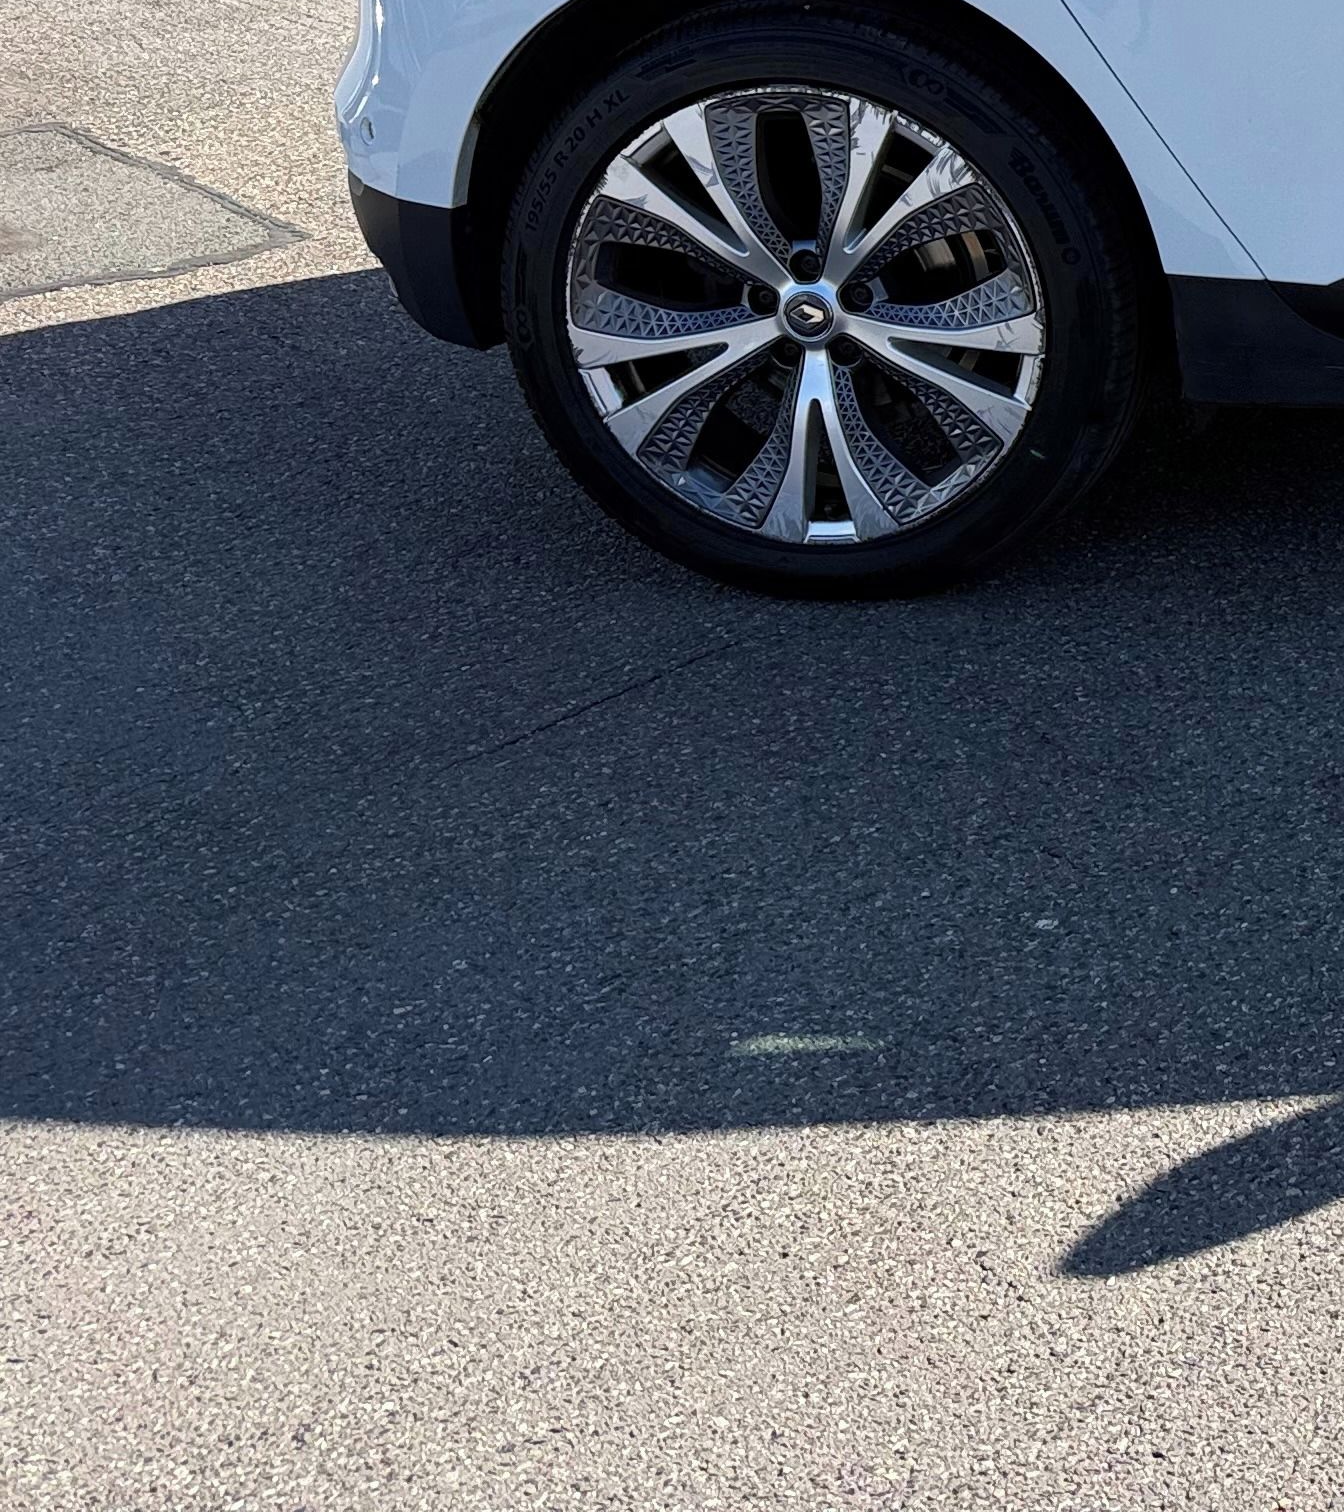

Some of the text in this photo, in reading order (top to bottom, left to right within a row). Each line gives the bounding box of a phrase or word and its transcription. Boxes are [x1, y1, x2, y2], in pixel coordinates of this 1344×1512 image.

[525, 90, 631, 231] 195/55 R 20 H XL
[1008, 149, 1070, 245] Barum
